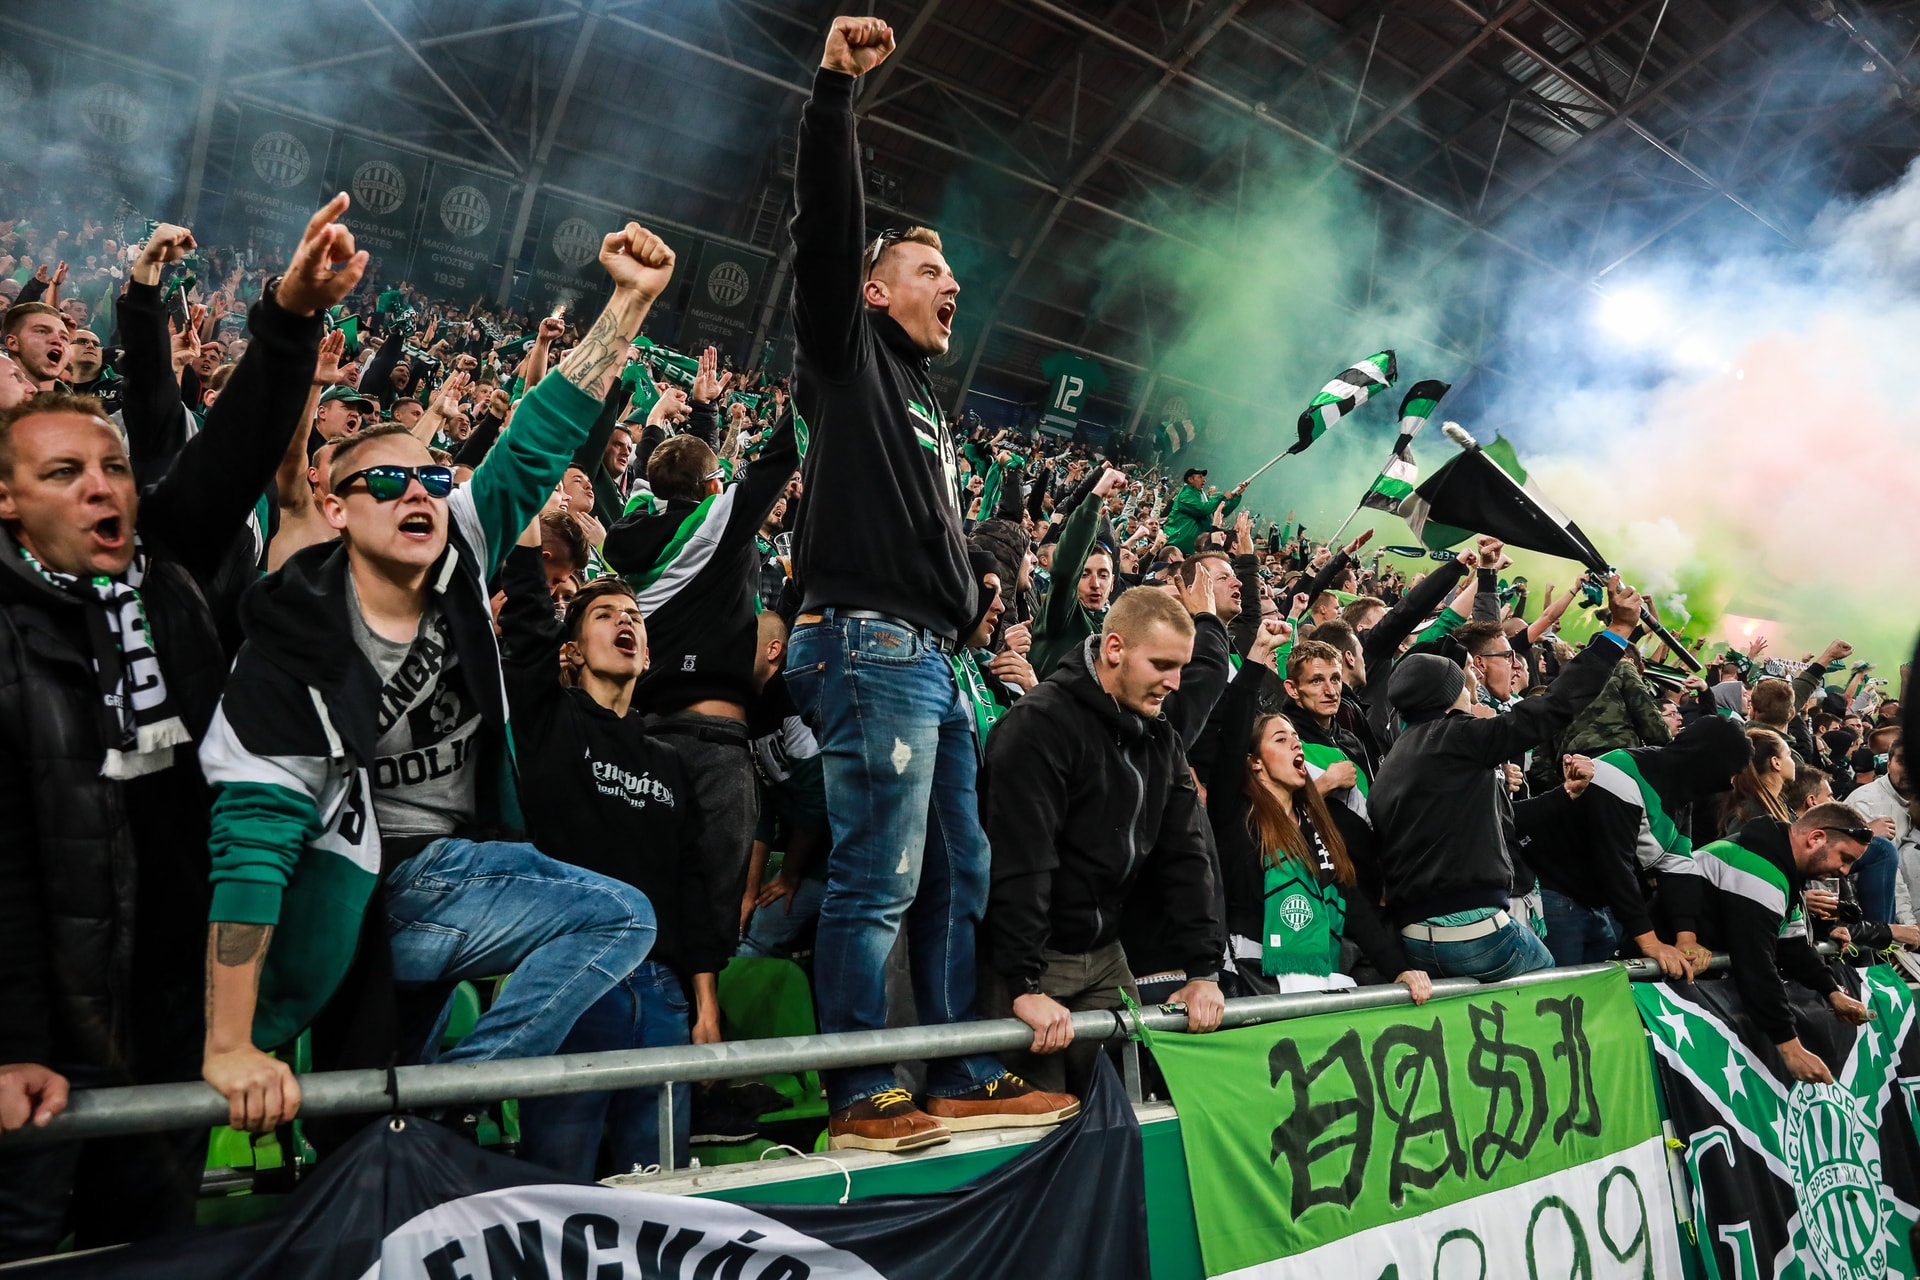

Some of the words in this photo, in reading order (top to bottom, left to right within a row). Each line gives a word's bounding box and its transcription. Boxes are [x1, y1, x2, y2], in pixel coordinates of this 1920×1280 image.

[232, 187, 279, 208] MAGYAR
[281, 201, 311, 216] KUPA
[249, 226, 286, 243] 1928
[354, 234, 393, 249] YŐZTES
[381, 226, 407, 240] KUPA
[422, 237, 462, 255] MAGYAR
[464, 248, 490, 262] KUPA
[433, 272, 466, 289] 1935
[536, 268, 574, 285] MAGYAR
[574, 279, 598, 292] KUPA
[1053, 374, 1084, 414] 12
